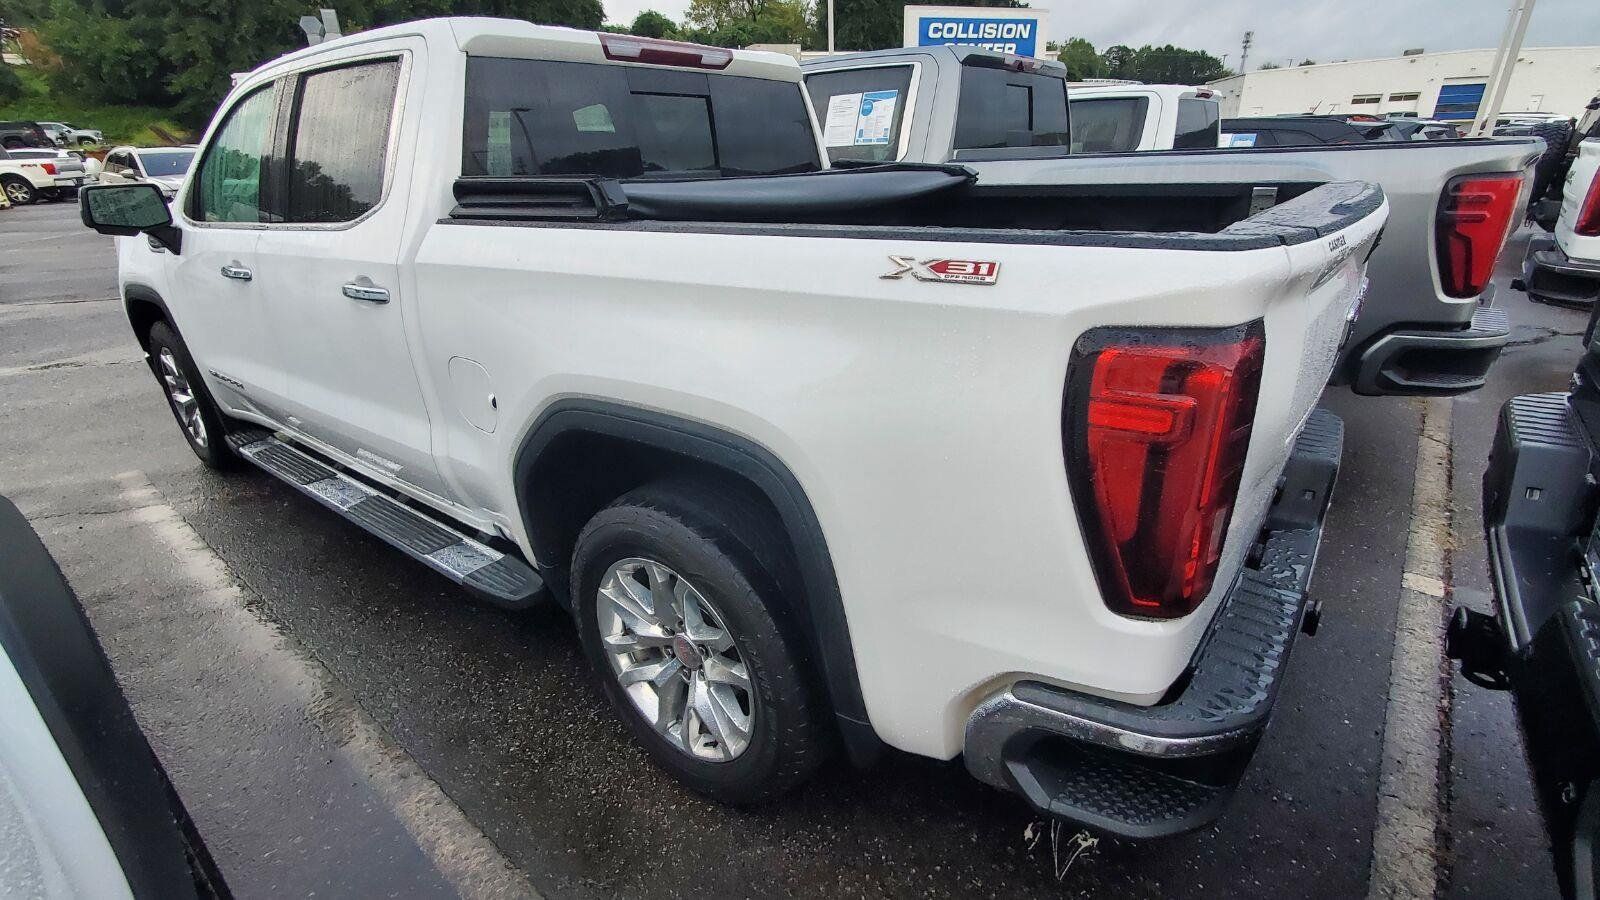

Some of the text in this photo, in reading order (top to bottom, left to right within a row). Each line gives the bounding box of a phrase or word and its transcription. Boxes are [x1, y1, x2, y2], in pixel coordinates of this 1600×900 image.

[928, 22, 1031, 39] COLLISION
[944, 43, 1017, 55] TER
[880, 256, 999, 284] X31
